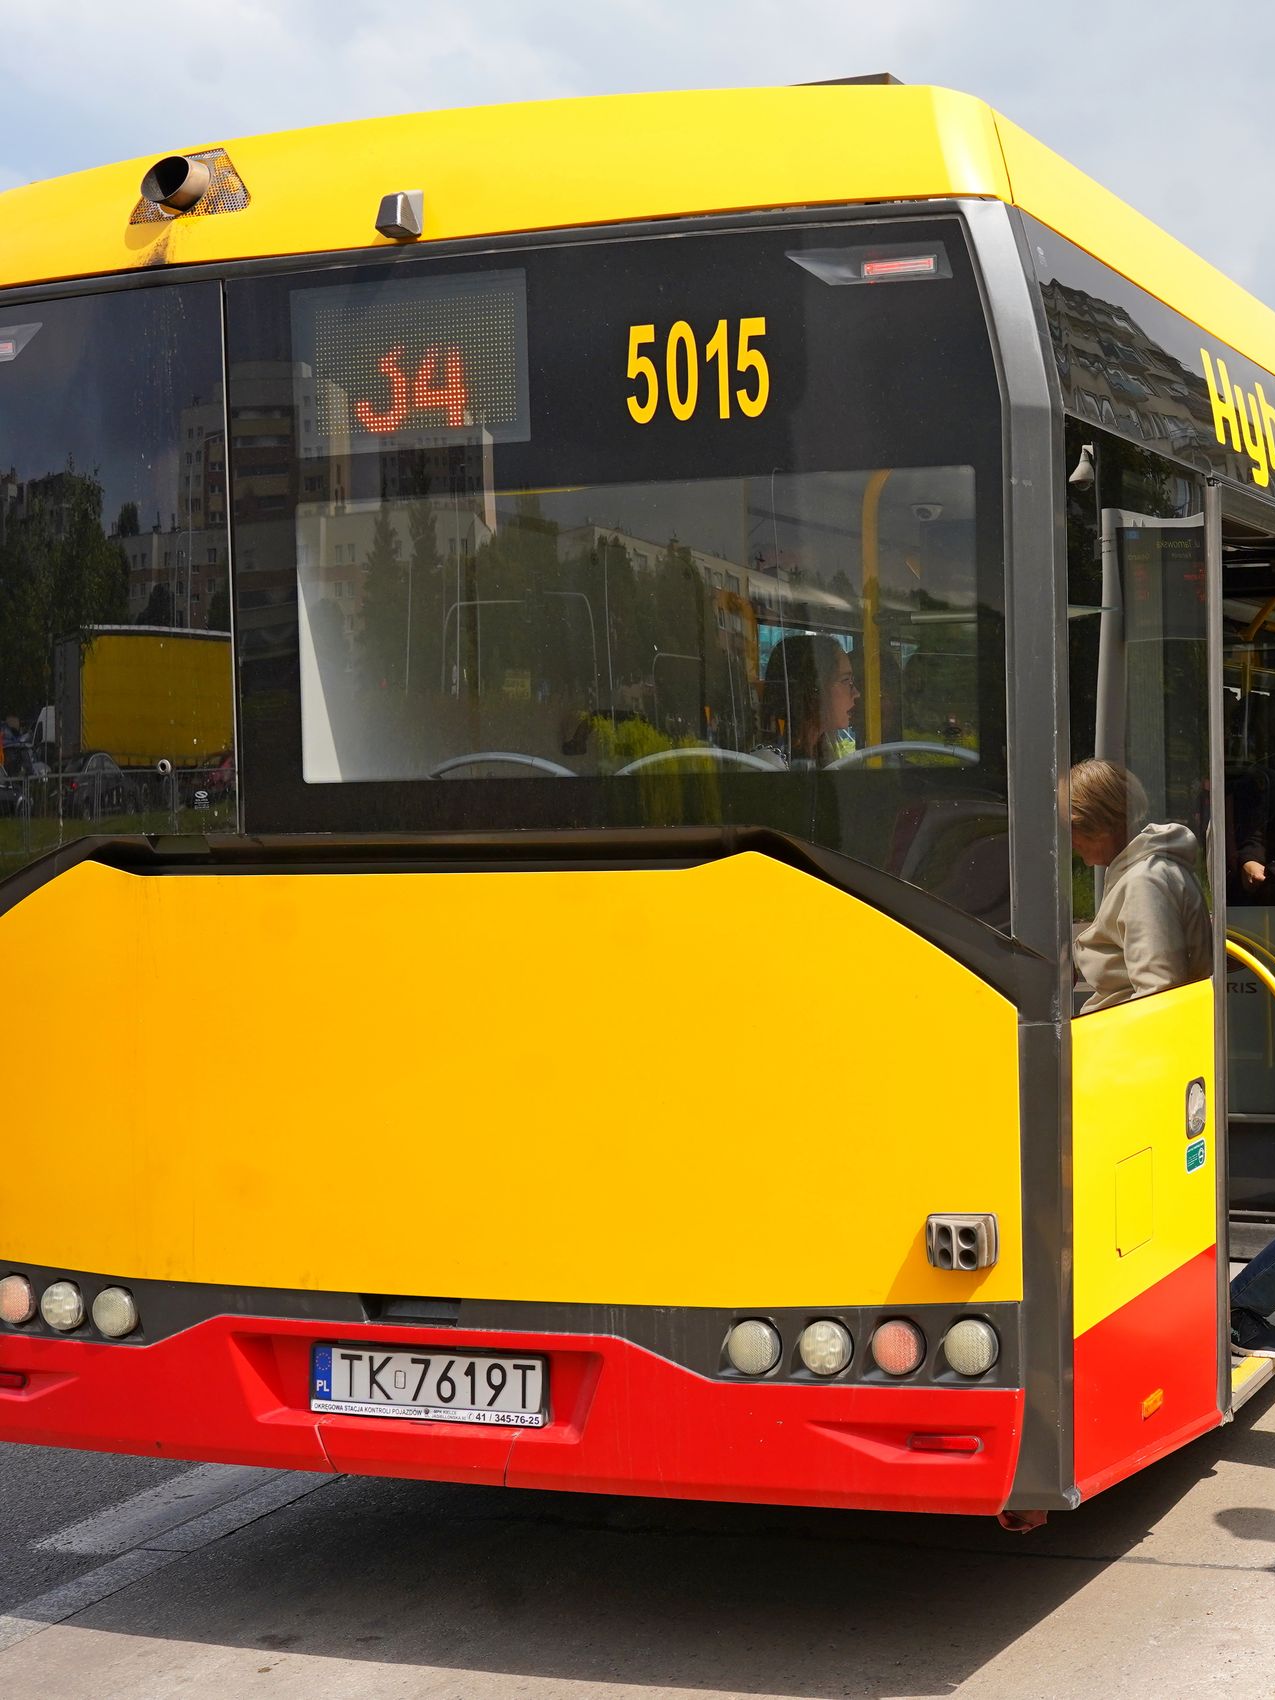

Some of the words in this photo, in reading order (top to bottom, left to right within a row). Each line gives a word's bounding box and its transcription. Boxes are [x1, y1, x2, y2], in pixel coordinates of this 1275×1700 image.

[625, 316, 771, 424] 5015
[316, 1380, 330, 1393] PL
[340, 1353, 393, 1400] TK
[410, 1357, 536, 1409] 7619T
[314, 1402, 344, 1412] OKRĘGOWA
[475, 1413, 487, 1421] 41
[494, 1414, 540, 1425] 345-76-25
